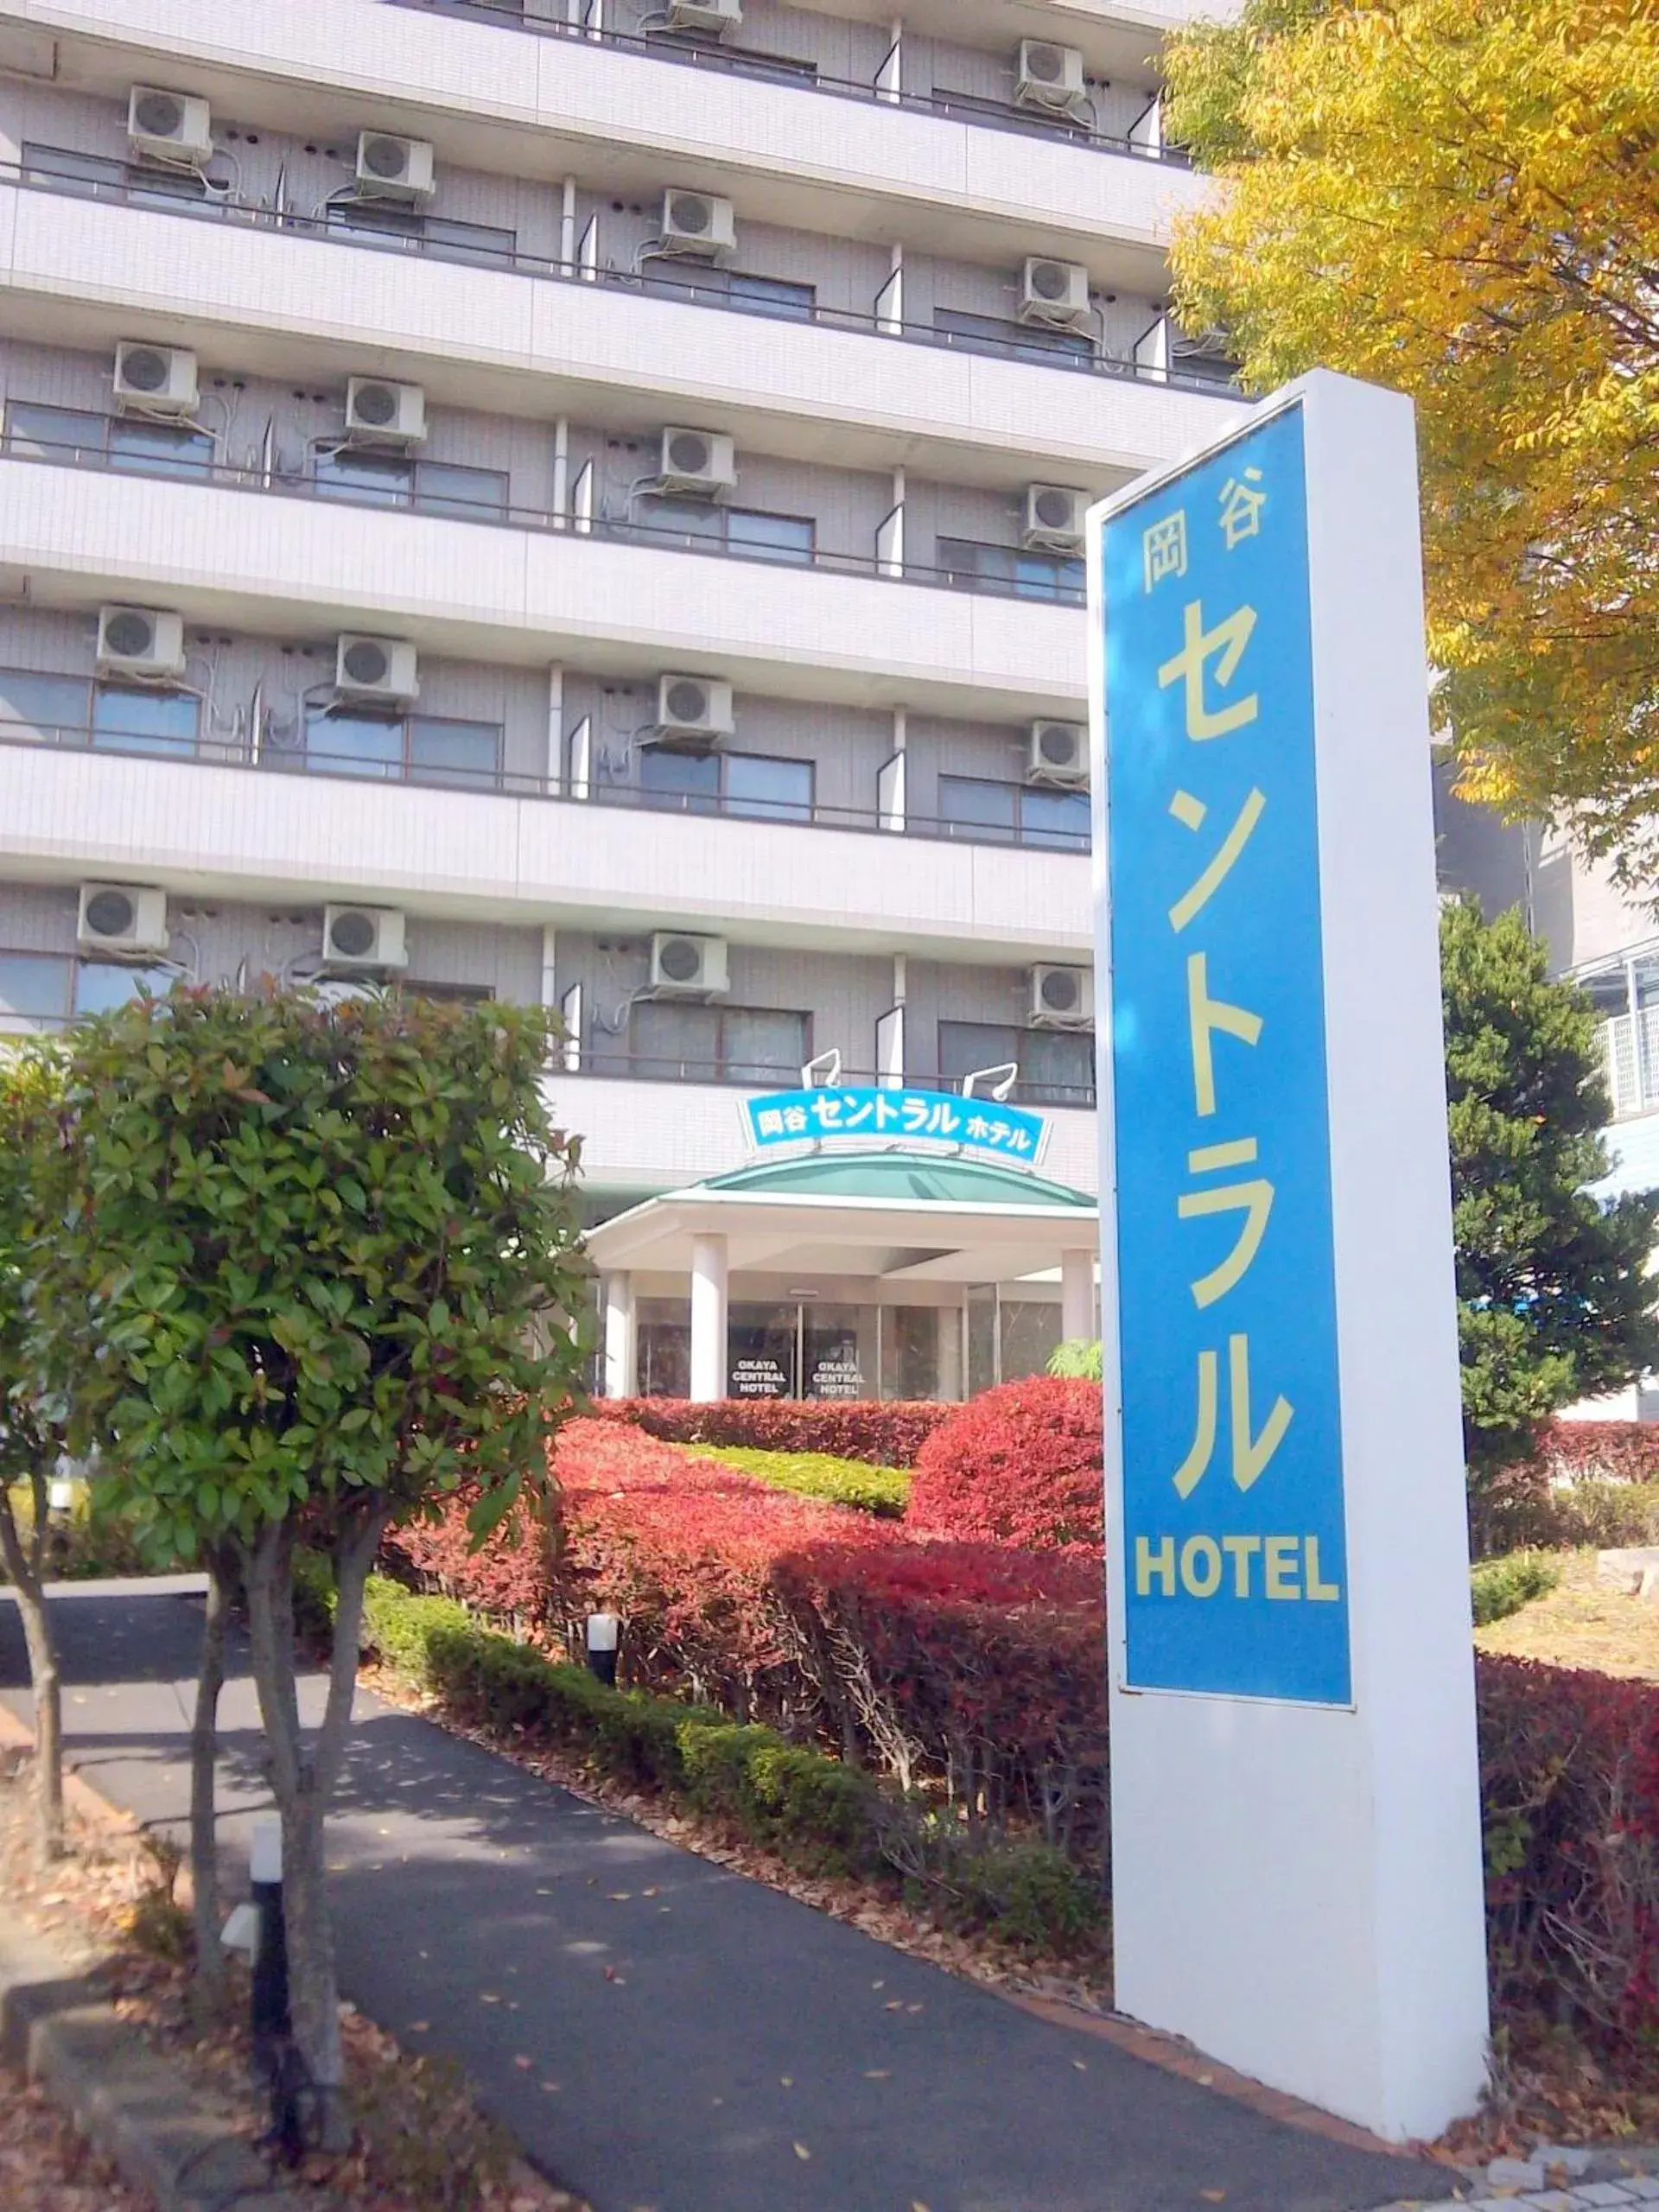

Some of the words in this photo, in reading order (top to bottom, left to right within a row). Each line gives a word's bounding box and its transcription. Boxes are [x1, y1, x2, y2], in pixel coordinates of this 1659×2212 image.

[1142, 467, 1268, 594] 岡谷
[1158, 599, 1295, 1500] セントラル
[757, 1105, 809, 1137] 岡谷
[810, 1094, 960, 1134] セントラル
[965, 1115, 1032, 1151] ホテル
[738, 1360, 778, 1370] OKAYA
[817, 1362, 857, 1372] OKAYA
[732, 1371, 786, 1382] CENTRAL
[812, 1373, 866, 1383] CENTRAL
[740, 1382, 779, 1394] HOTEL
[820, 1384, 859, 1395] HOTEL
[1135, 1535, 1340, 1603] HOTEL
